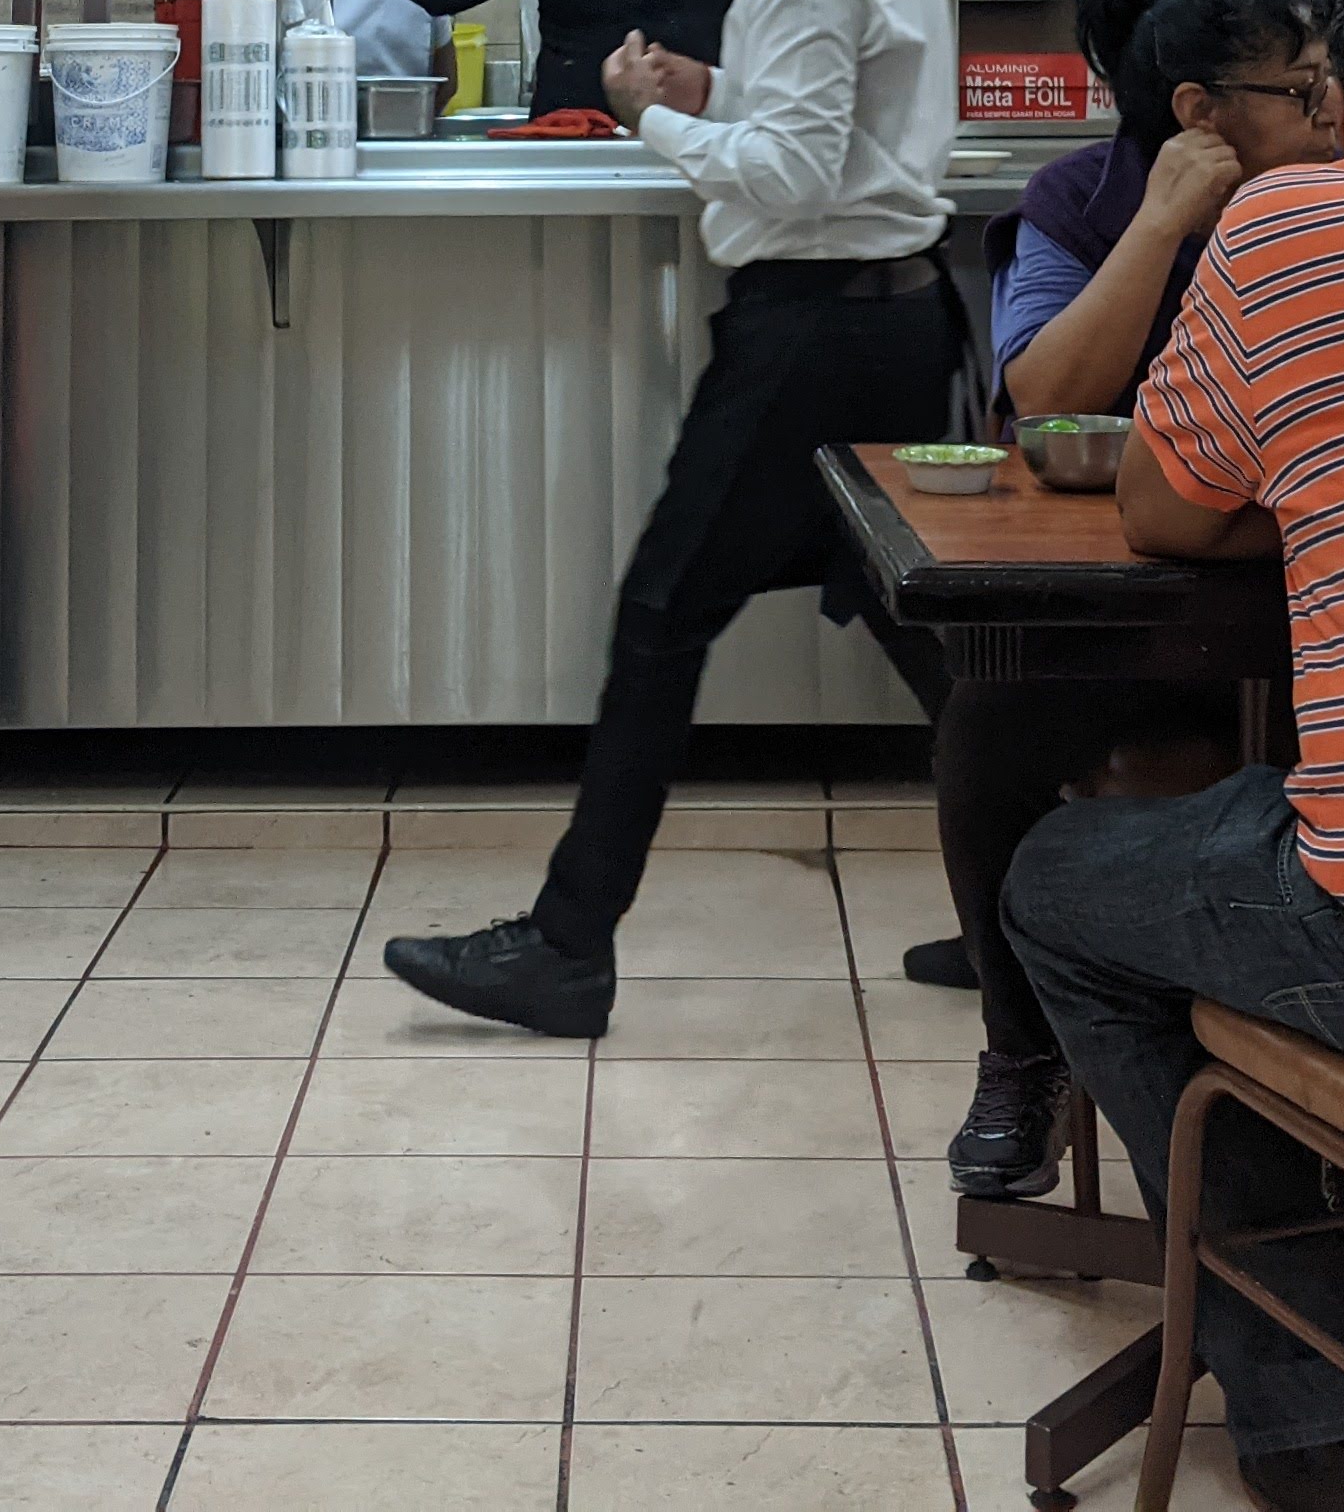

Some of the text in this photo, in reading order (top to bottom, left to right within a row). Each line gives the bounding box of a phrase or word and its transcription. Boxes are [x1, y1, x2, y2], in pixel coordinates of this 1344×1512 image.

[966, 64, 1038, 73] ALUMINIO
[966, 88, 1012, 107] Meta
[1025, 88, 1072, 106] FOIL
